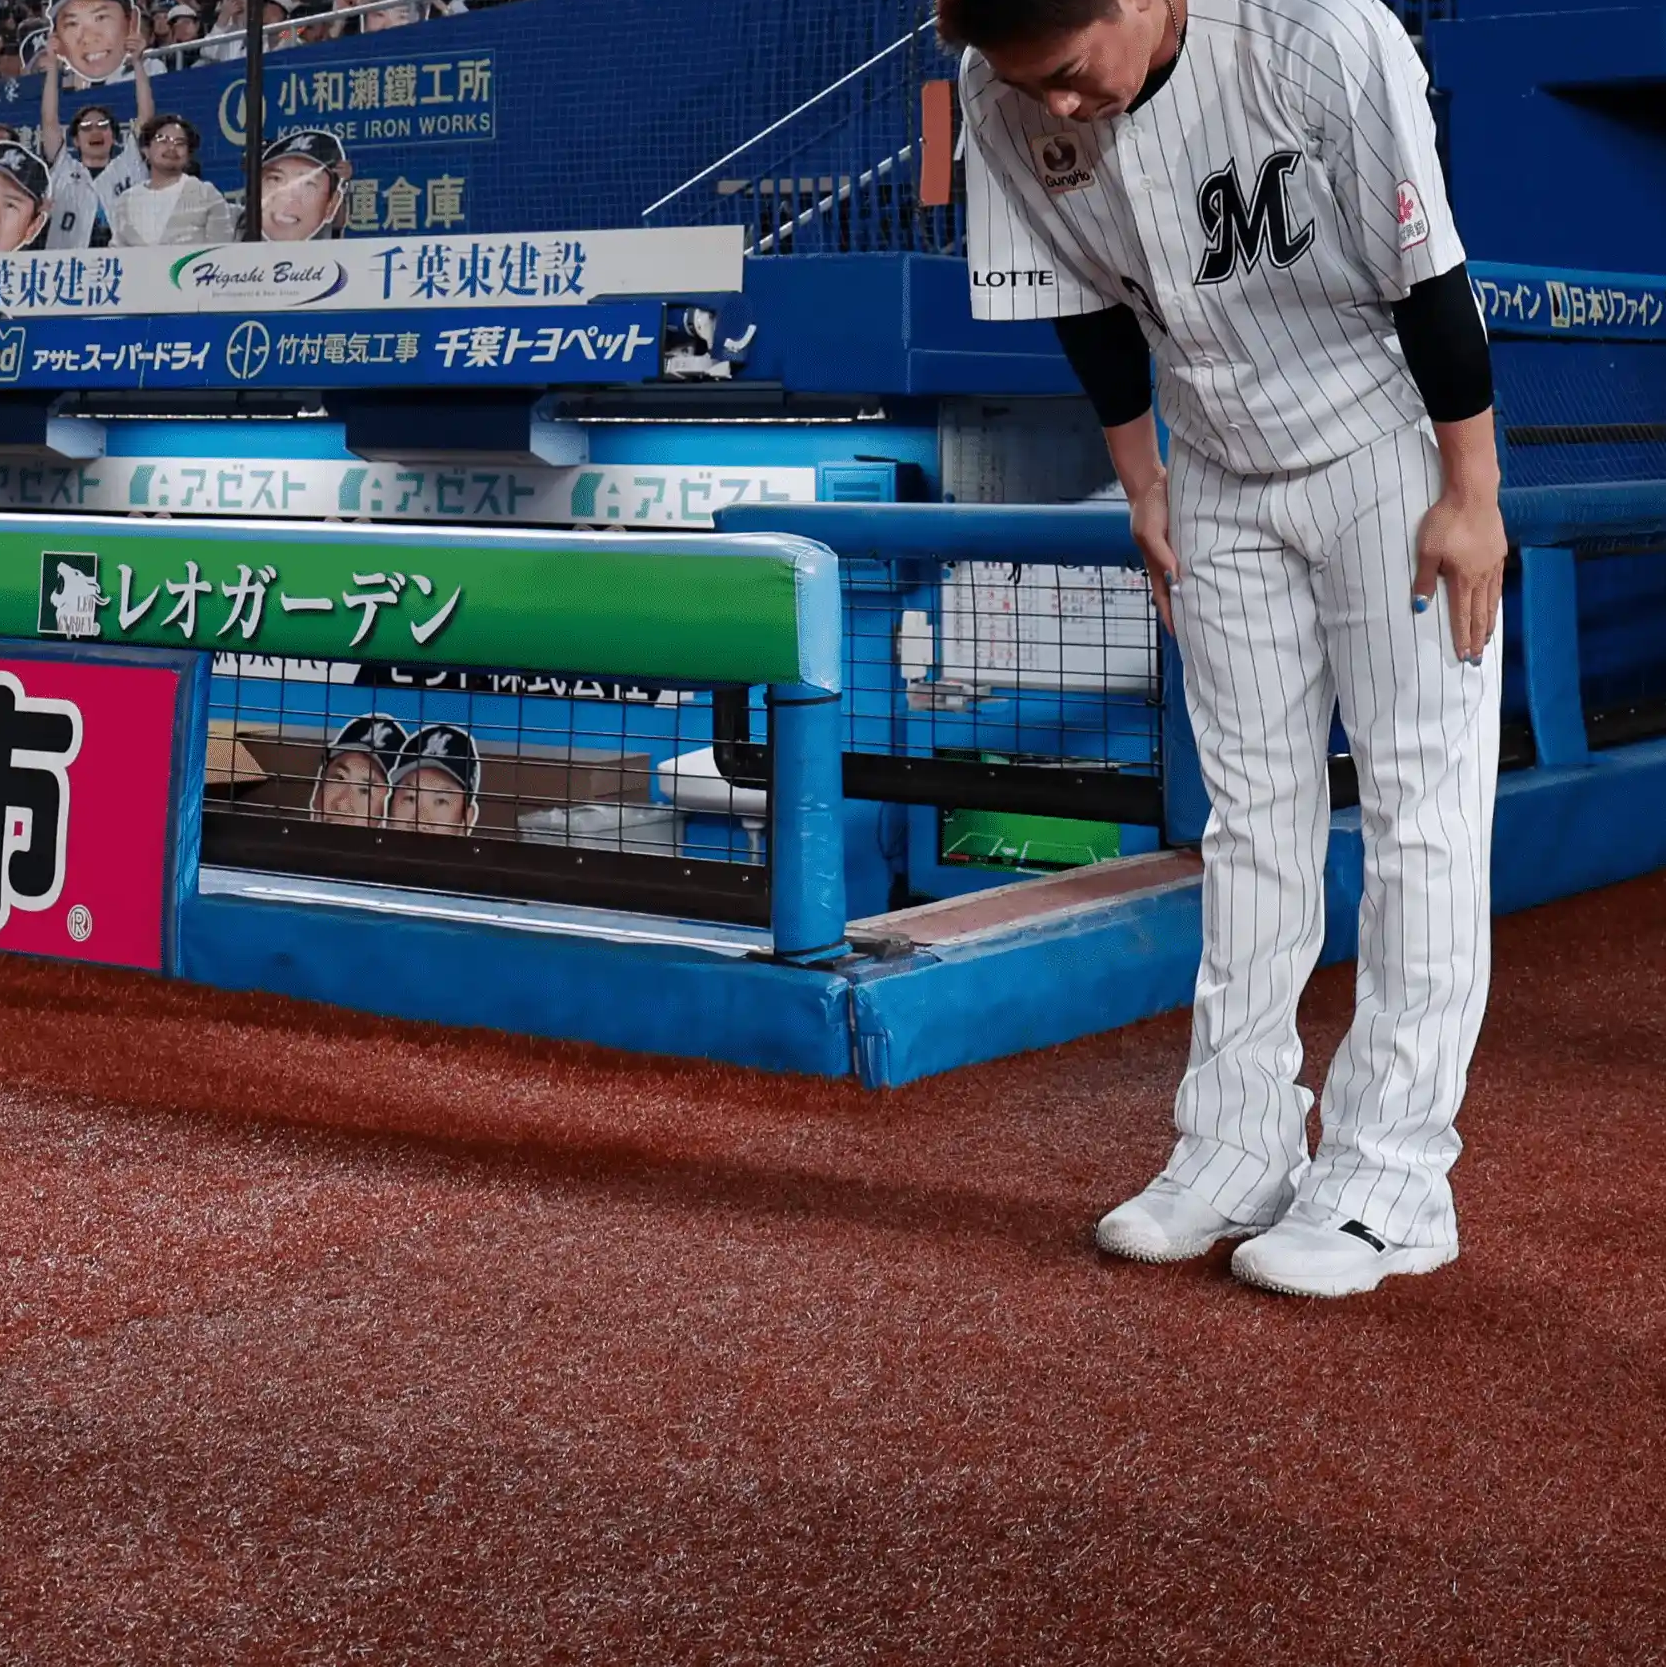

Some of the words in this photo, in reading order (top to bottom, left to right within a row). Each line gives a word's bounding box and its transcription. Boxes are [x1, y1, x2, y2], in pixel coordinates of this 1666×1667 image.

[364, 117, 413, 139] IRON
[419, 112, 491, 135] WORKS
[1044, 170, 1092, 189] GungHo
[1194, 150, 1316, 285] M
[193, 262, 265, 289] Higashi
[273, 261, 325, 283] Build
[369, 239, 588, 302] 千葉東建設
[973, 269, 1054, 289] LOTTE
[1571, 286, 1665, 328] 日本リファイン
[276, 332, 420, 370] 竹村電気工事
[435, 323, 656, 369] 千葉トヨペット
[116, 559, 462, 646] レオガーデン
